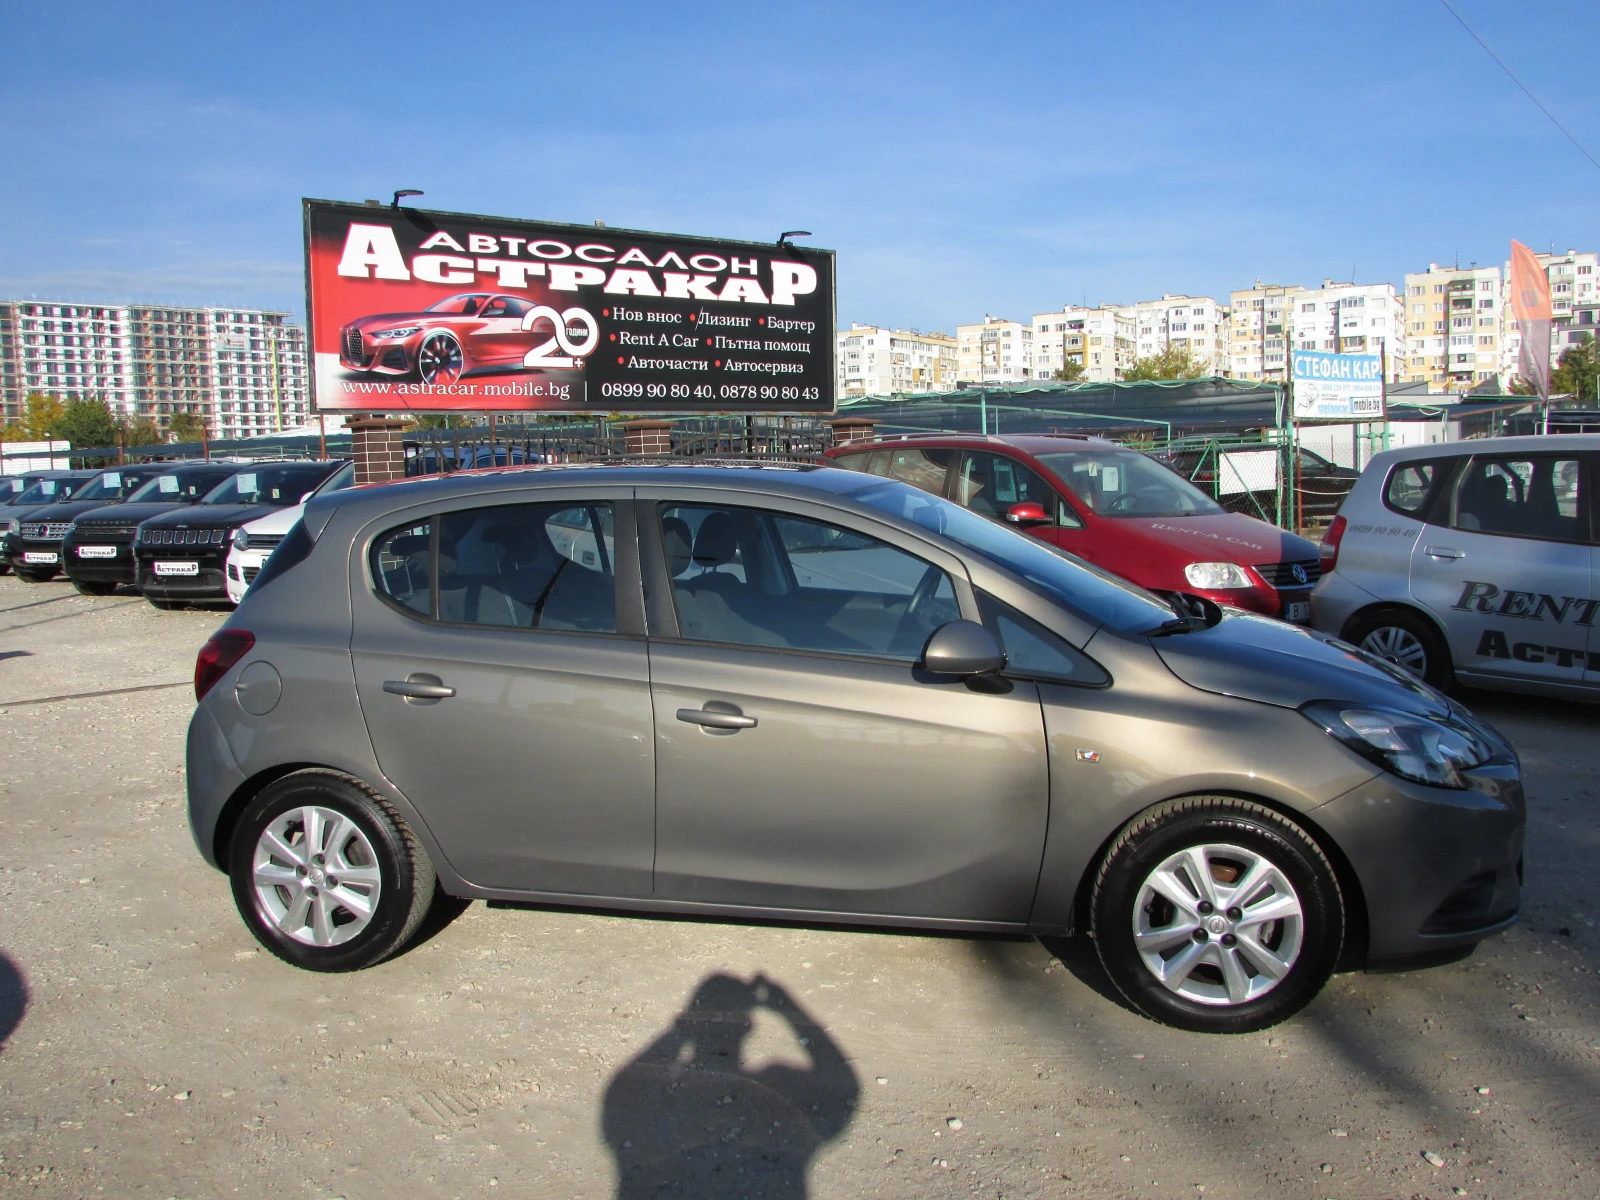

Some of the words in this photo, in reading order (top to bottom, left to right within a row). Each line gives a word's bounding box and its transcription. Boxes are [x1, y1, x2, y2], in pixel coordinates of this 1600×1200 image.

[419, 231, 758, 275] АВТОСАЛОН
[337, 222, 817, 306] АСТРАКАР
[612, 307, 643, 321] Нов
[647, 310, 682, 324] внос
[697, 312, 752, 327] Лизинг
[767, 316, 815, 333] Бартер
[565, 327, 589, 337] ГОДИНИ
[619, 332, 656, 346] Rent
[658, 333, 670, 346] A
[673, 334, 699, 348] Car
[715, 336, 761, 351] Пътна
[764, 340, 811, 354] помощ
[627, 355, 709, 371] Авточасти
[724, 359, 804, 375] Автосервиз
[1295, 356, 1351, 379] СТЕФАН
[1352, 360, 1380, 379] КАР
[341, 381, 570, 400] www.astracar.mobile.bg
[601, 383, 643, 397] 0899
[647, 384, 667, 397] 90
[670, 384, 690, 398] 80
[693, 385, 716, 400] 40,
[720, 385, 757, 399] 0878
[760, 386, 778, 399] 90
[781, 386, 799, 399] 80
[802, 387, 820, 400] 43
[1353, 399, 1380, 411] mobile.bg
[1151, 523, 1263, 551] RENT-A-CAR
[1349, 524, 1373, 533] 0899
[1373, 526, 1387, 534] 90
[1387, 528, 1401, 536] 80
[1402, 529, 1416, 538] 40
[157, 564, 197, 572] АСТРАКАР
[1450, 580, 1600, 628] RENT
